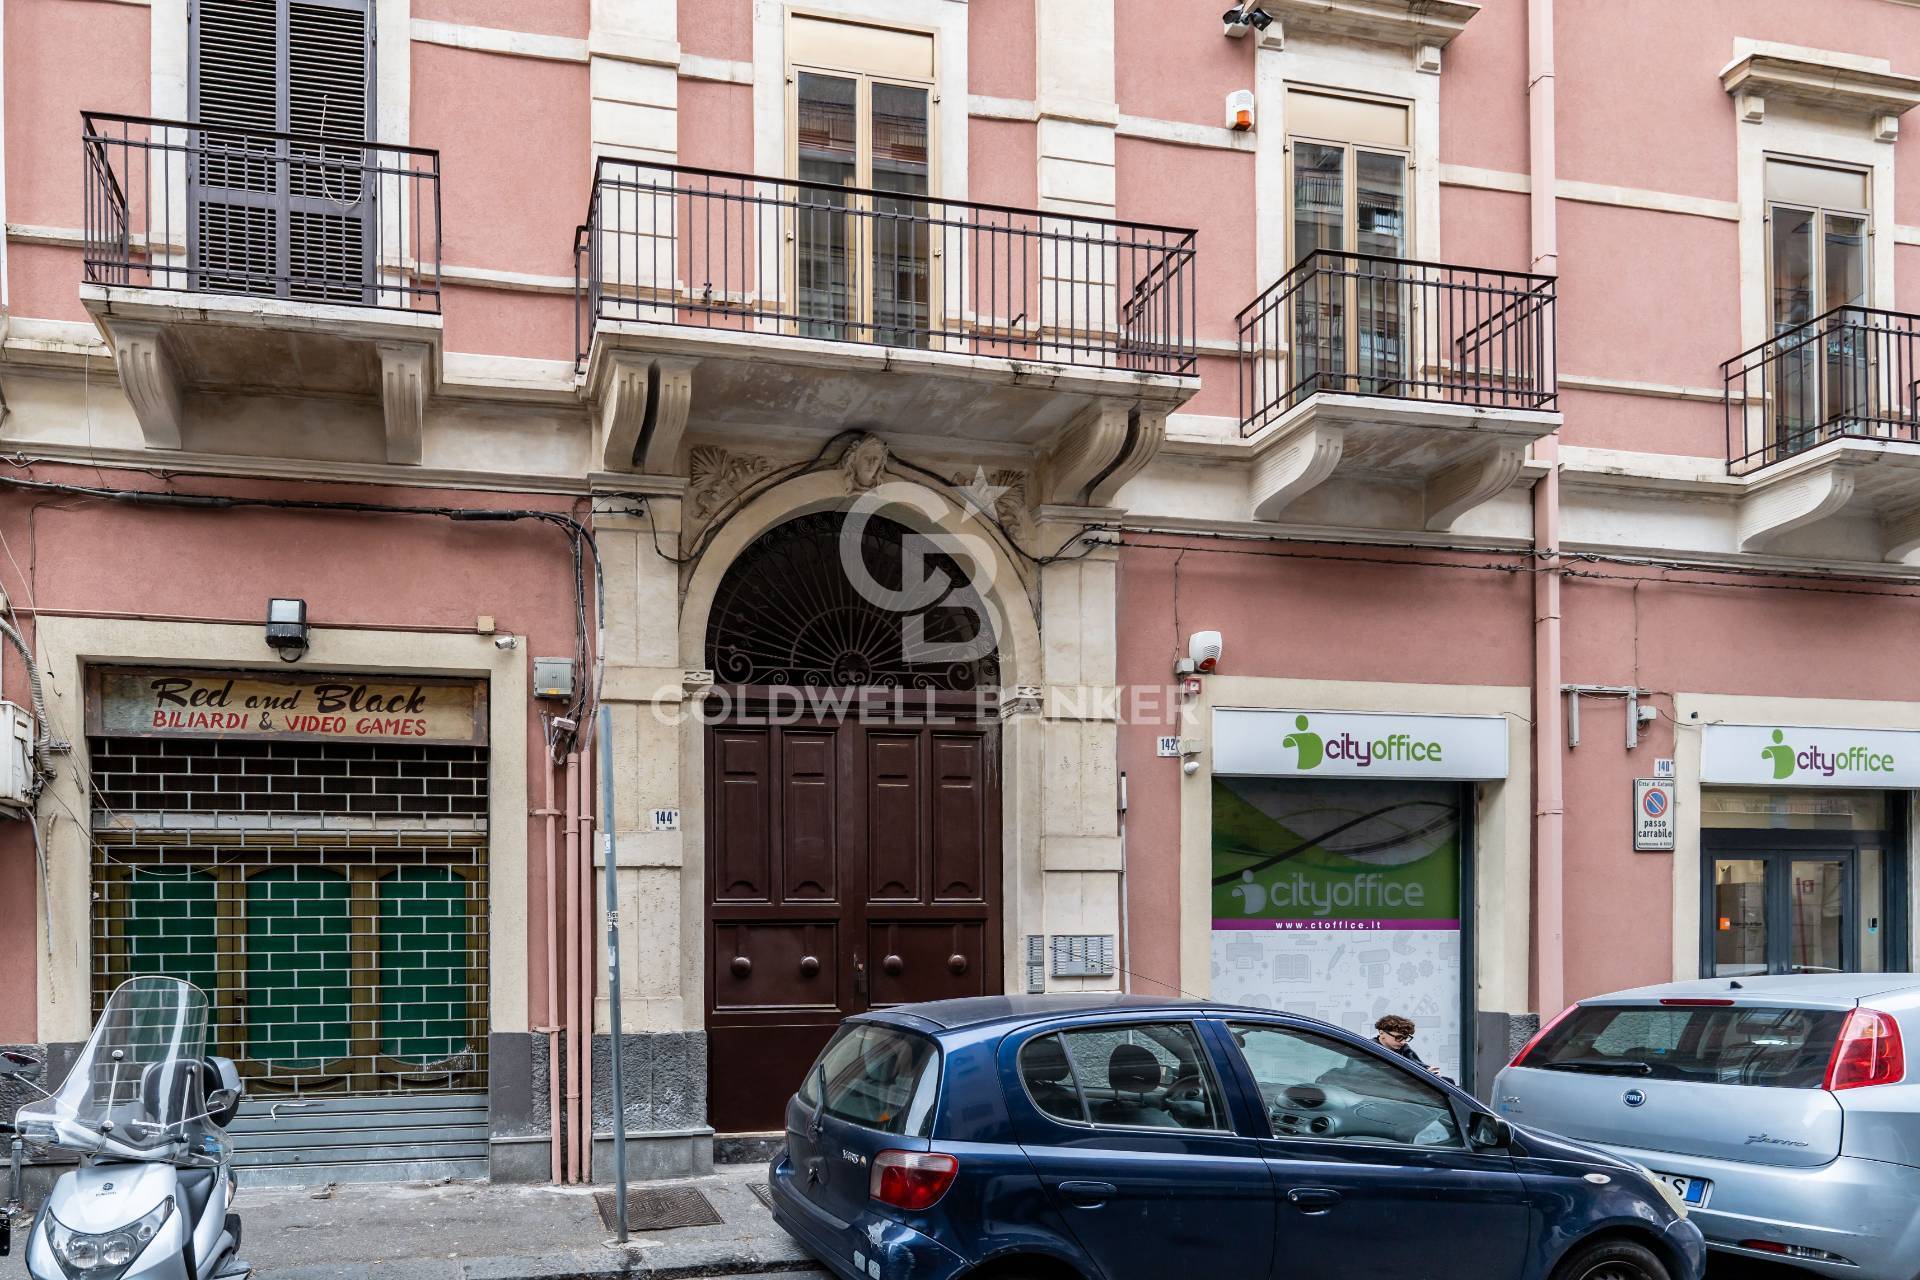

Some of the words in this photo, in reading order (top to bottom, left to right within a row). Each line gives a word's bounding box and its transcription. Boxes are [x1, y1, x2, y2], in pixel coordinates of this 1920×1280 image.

[150, 677, 234, 709] Red
[245, 689, 302, 711] and
[313, 684, 427, 715] Black
[152, 710, 249, 730] BILIARDI
[258, 711, 275, 731] &
[285, 715, 347, 734] VIDEO
[355, 717, 427, 737] GAMES
[1161, 738, 1176, 751] 142
[1325, 732, 1442, 767] cityoffice
[1796, 745, 1895, 777] cityoffice
[655, 811, 673, 825] 144
[1644, 820, 1666, 828] passo
[1638, 829, 1673, 838] carrabile
[1270, 873, 1425, 916] cityoffice
[1275, 920, 1382, 930] www.ctoffice.it
[1625, 1094, 1642, 1102] FIAT
